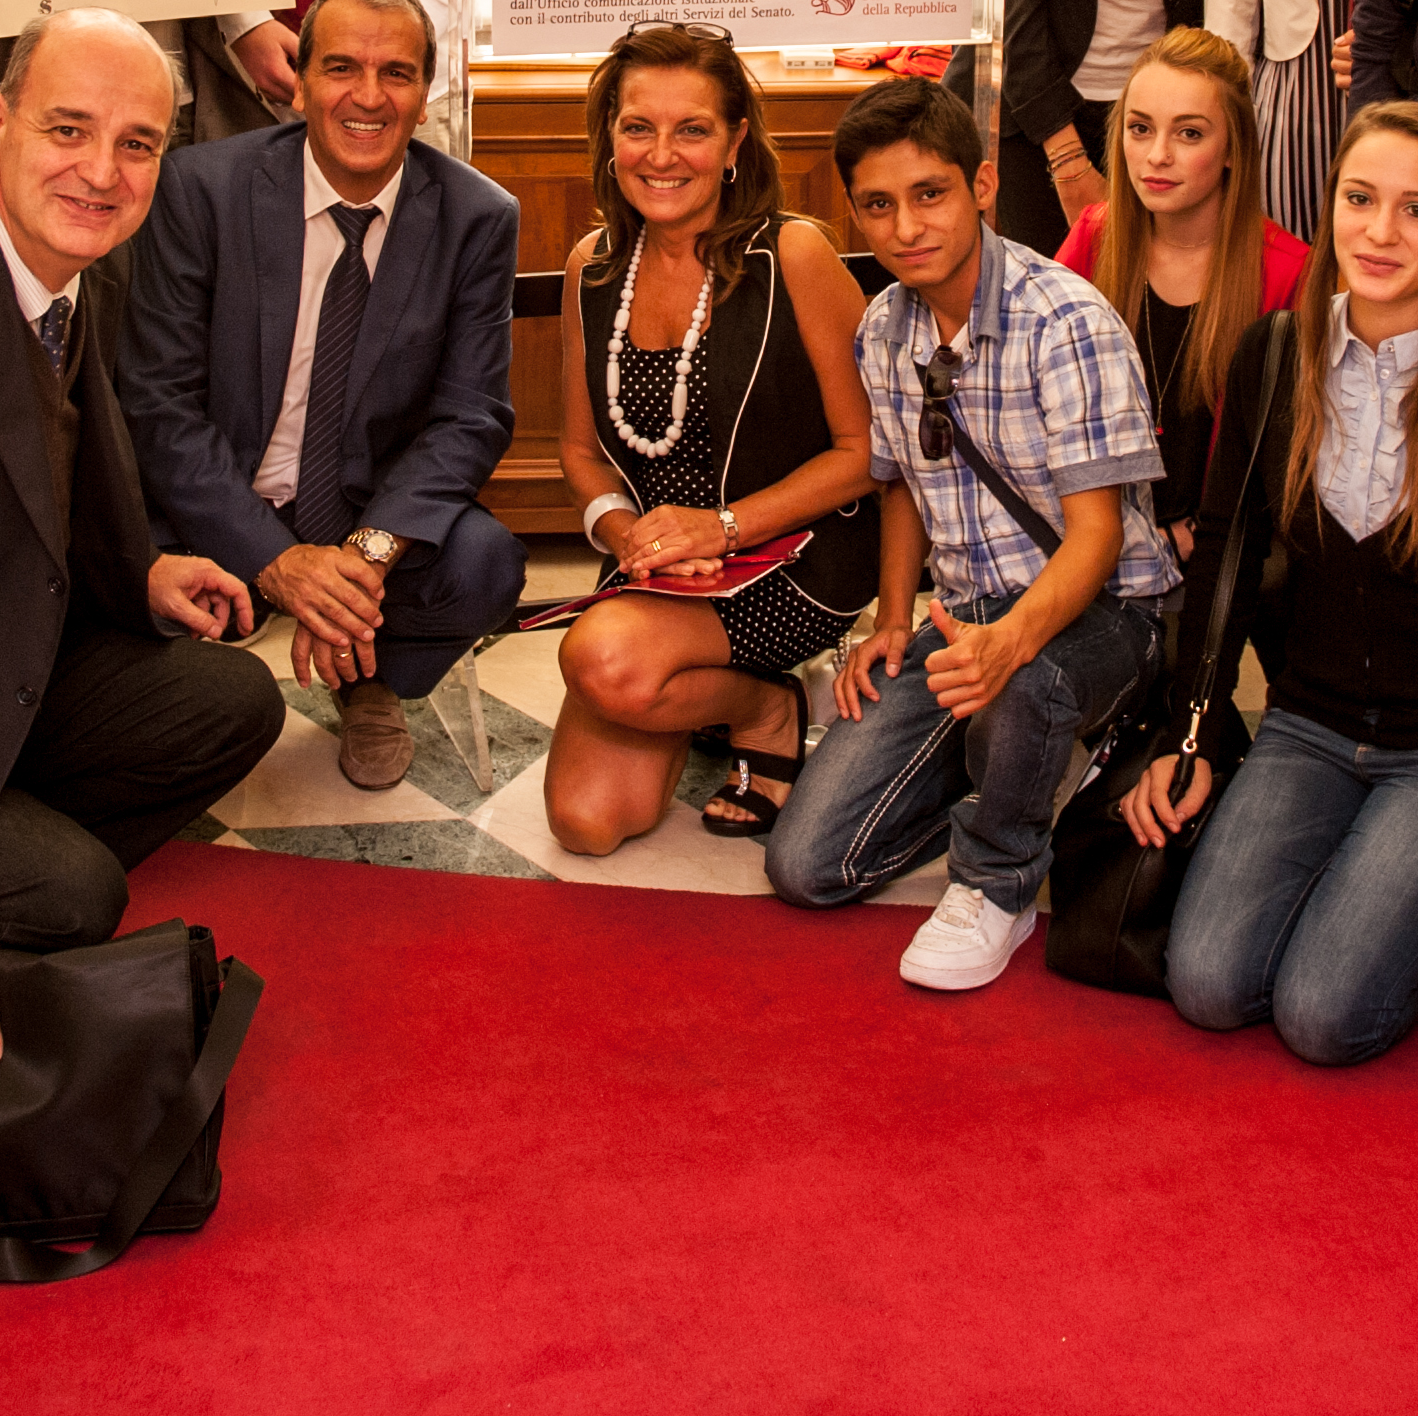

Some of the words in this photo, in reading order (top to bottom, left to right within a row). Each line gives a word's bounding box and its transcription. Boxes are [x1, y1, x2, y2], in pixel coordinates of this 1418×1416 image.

[510, 16, 532, 25] con
[538, 12, 545, 24] il
[549, 11, 614, 24] contributo
[619, 9, 649, 22] degli
[653, 8, 679, 20] altri
[683, 7, 724, 20] Servizi
[728, 6, 746, 18] del
[751, 6, 795, 18] Senato.
[862, 3, 889, 15] della
[894, 1, 957, 17] Repubblica
